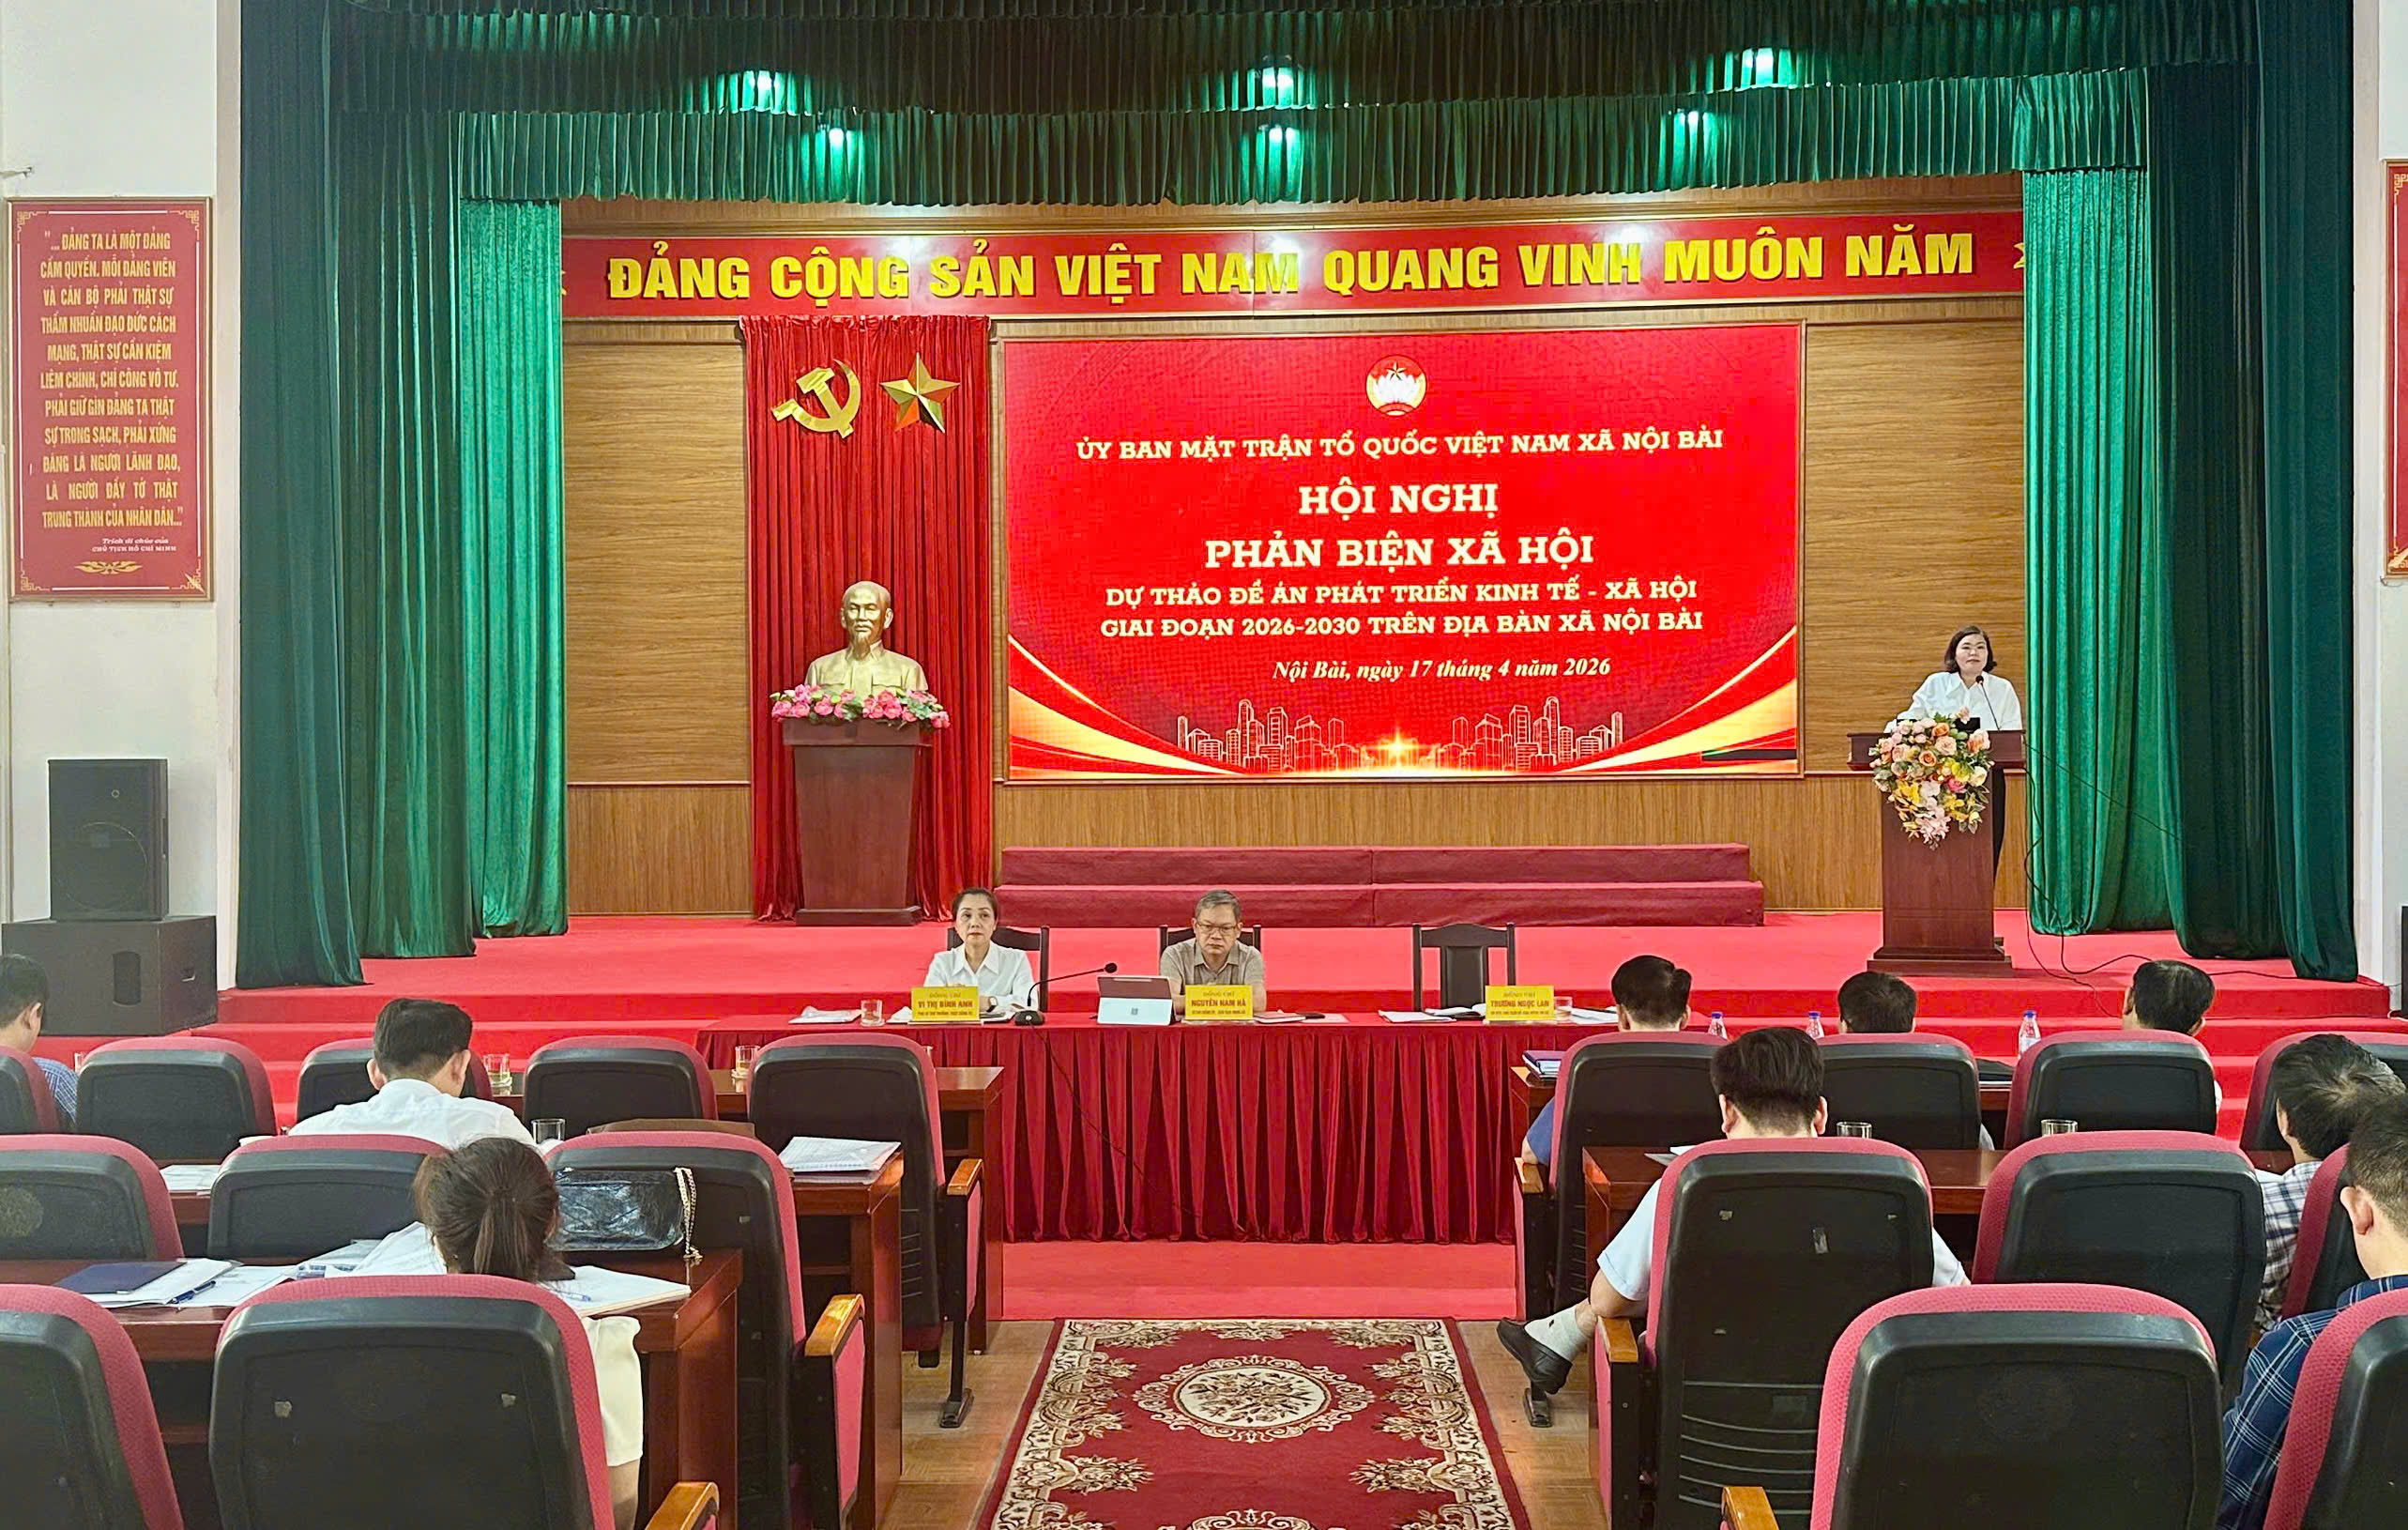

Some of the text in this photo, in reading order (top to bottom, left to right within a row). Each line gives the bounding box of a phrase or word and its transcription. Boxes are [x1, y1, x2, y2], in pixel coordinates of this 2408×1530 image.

[608, 223, 1974, 307] ĐẢNG CỘNG SẢN VIỆT NAM QUANG VINH MUÔN NĂM
[1076, 424, 1723, 462] ỦY BAN MẶT TRẬN TỔ QUỐC VIỆT NAM XÃ NỘI BÀI
[1299, 477, 1499, 521] HỘI NGHỊ
[1205, 528, 1594, 573] PHẢN BIỆN XÃ HỘI
[1105, 586, 1144, 609] DỰ
[1151, 582, 1222, 605] THẢO
[1271, 581, 1308, 604] ÁN
[1315, 581, 1384, 604] PHÁT
[1391, 576, 1469, 603] TRIỂN
[1476, 584, 1539, 602] KINH
[1547, 574, 1580, 601] TẾ
[1604, 578, 1642, 600] XÃ
[1649, 575, 1698, 603] HỘI
[1100, 606, 1703, 640] GIAI ĐOẠN 2026-2030 TRÊN ĐỊA BÀN XÃ NỘI BÀI
[1273, 658, 1611, 682] Nội Bài, ngày 17 tháng 4 năm 2026
